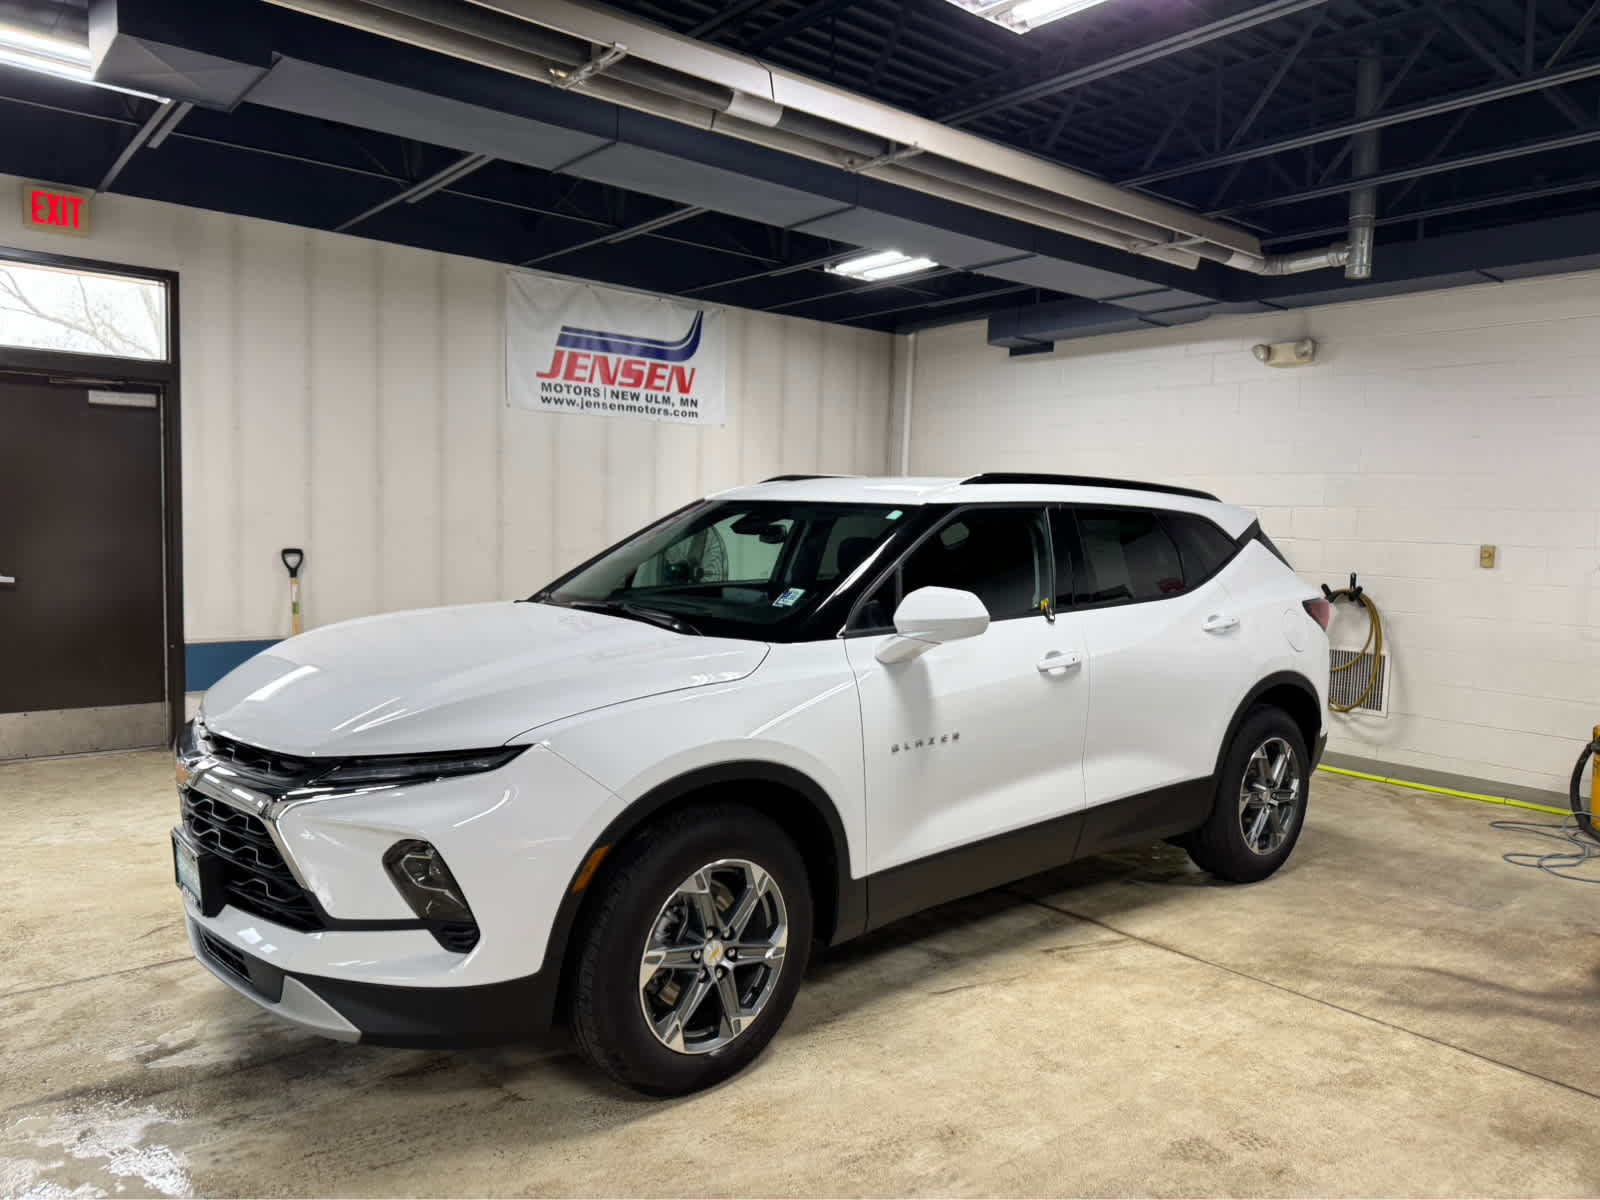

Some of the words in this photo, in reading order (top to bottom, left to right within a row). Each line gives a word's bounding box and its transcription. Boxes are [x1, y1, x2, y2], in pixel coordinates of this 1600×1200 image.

[32, 191, 83, 228] EXIT
[536, 350, 696, 394] JENSEN
[541, 382, 600, 398] MOTORS
[610, 389, 640, 402] NEW
[645, 394, 675, 408] ULM,
[680, 397, 698, 408] MN
[541, 395, 698, 419] www.jensenmotors.com
